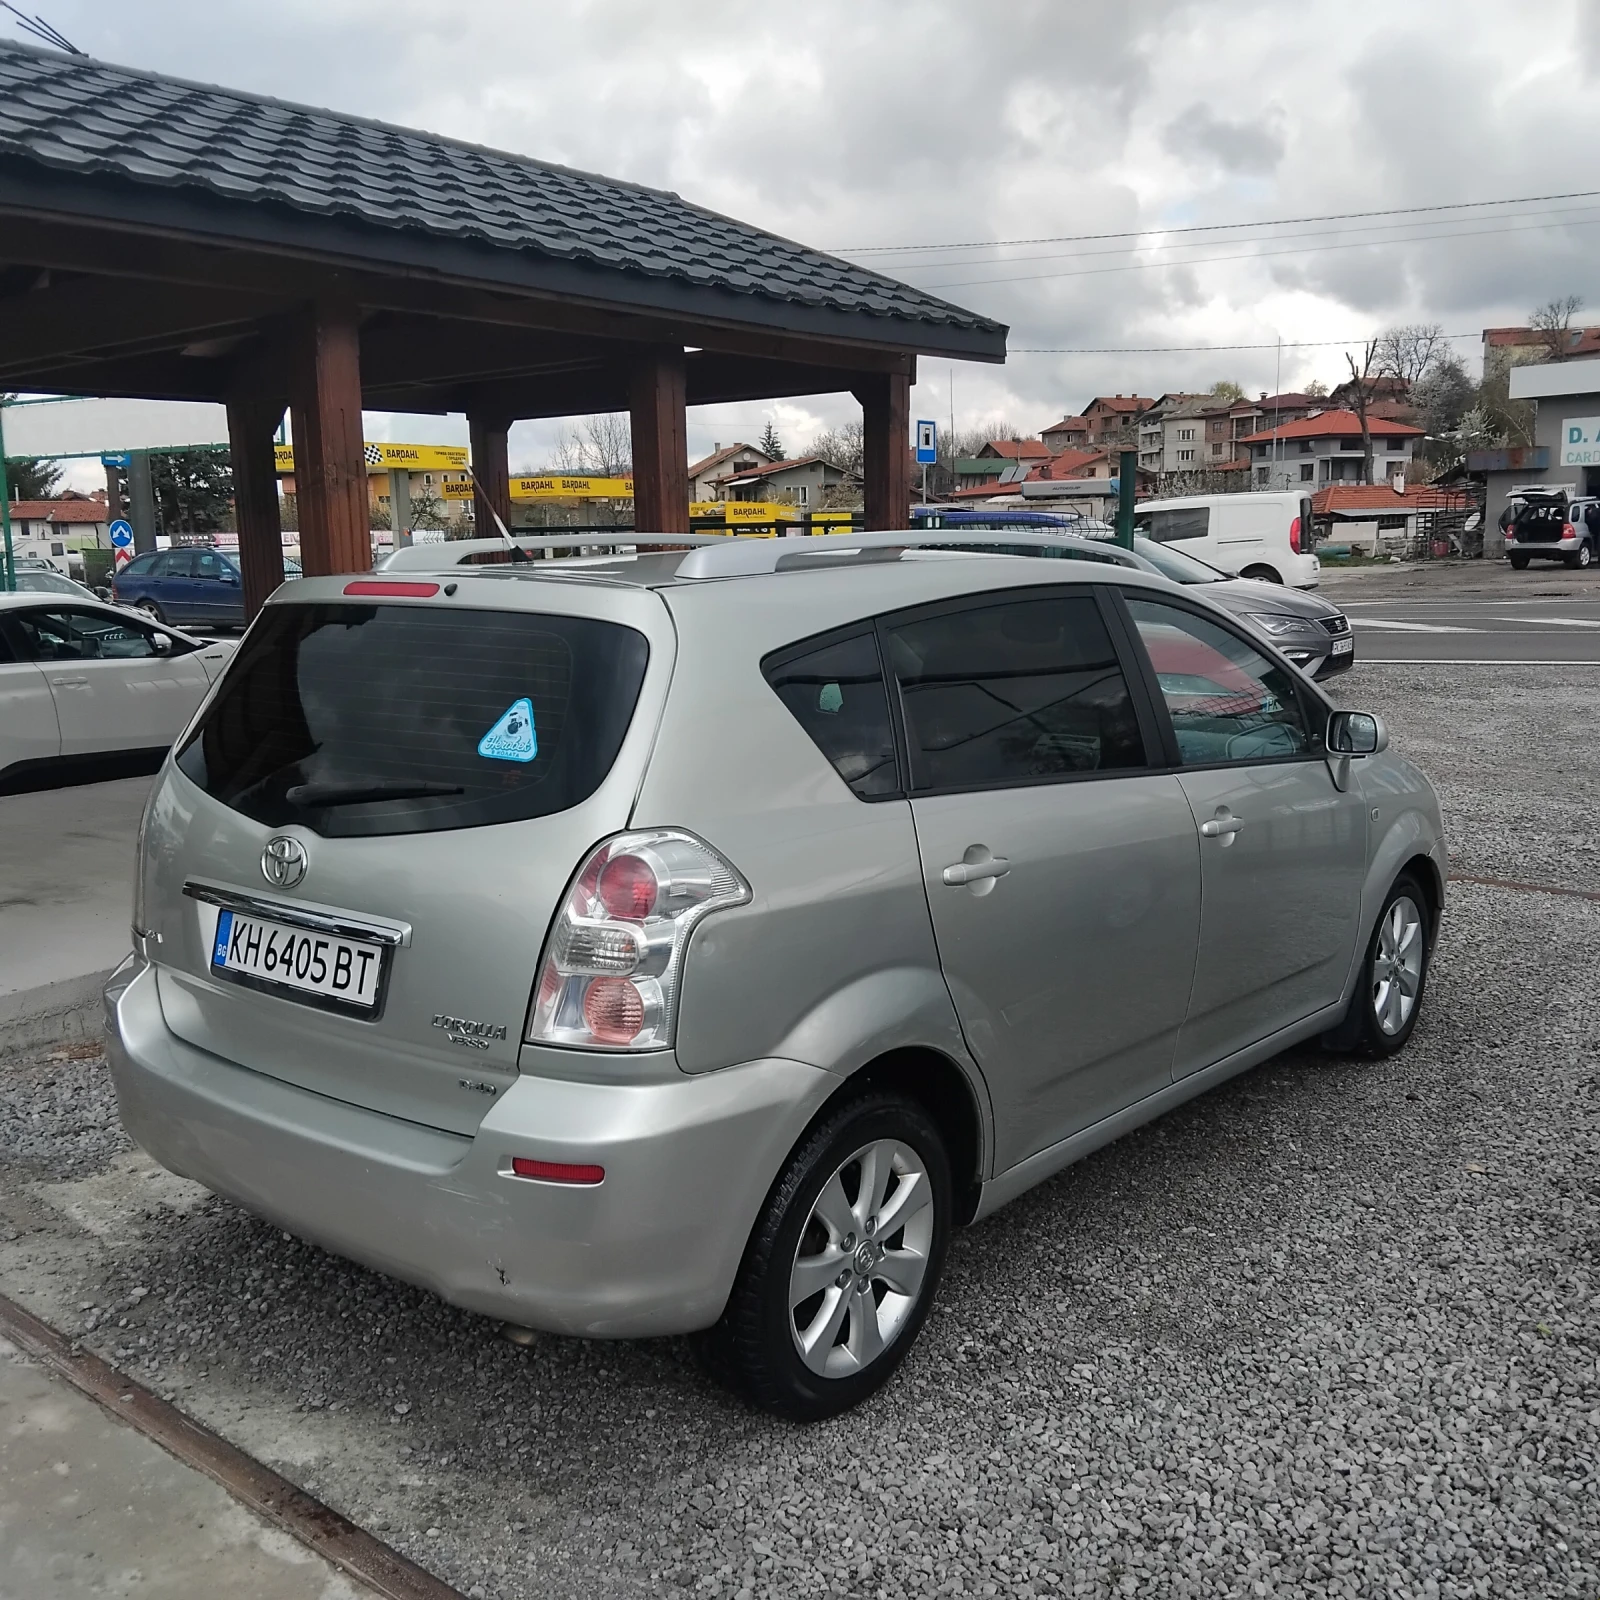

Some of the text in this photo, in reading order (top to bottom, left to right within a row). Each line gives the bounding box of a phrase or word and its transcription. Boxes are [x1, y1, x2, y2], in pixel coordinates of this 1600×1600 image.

[274, 451, 293, 464] ARDA
[386, 449, 419, 462] BARDAHL
[446, 484, 474, 496] BARDAH
[521, 480, 554, 493] BARDAHL
[562, 480, 590, 493] BARDAHL
[733, 508, 767, 519] BARDAHL
[217, 944, 226, 957] BG
[432, 1013, 506, 1040] COROLLA
[446, 1032, 490, 1050] VERSO
